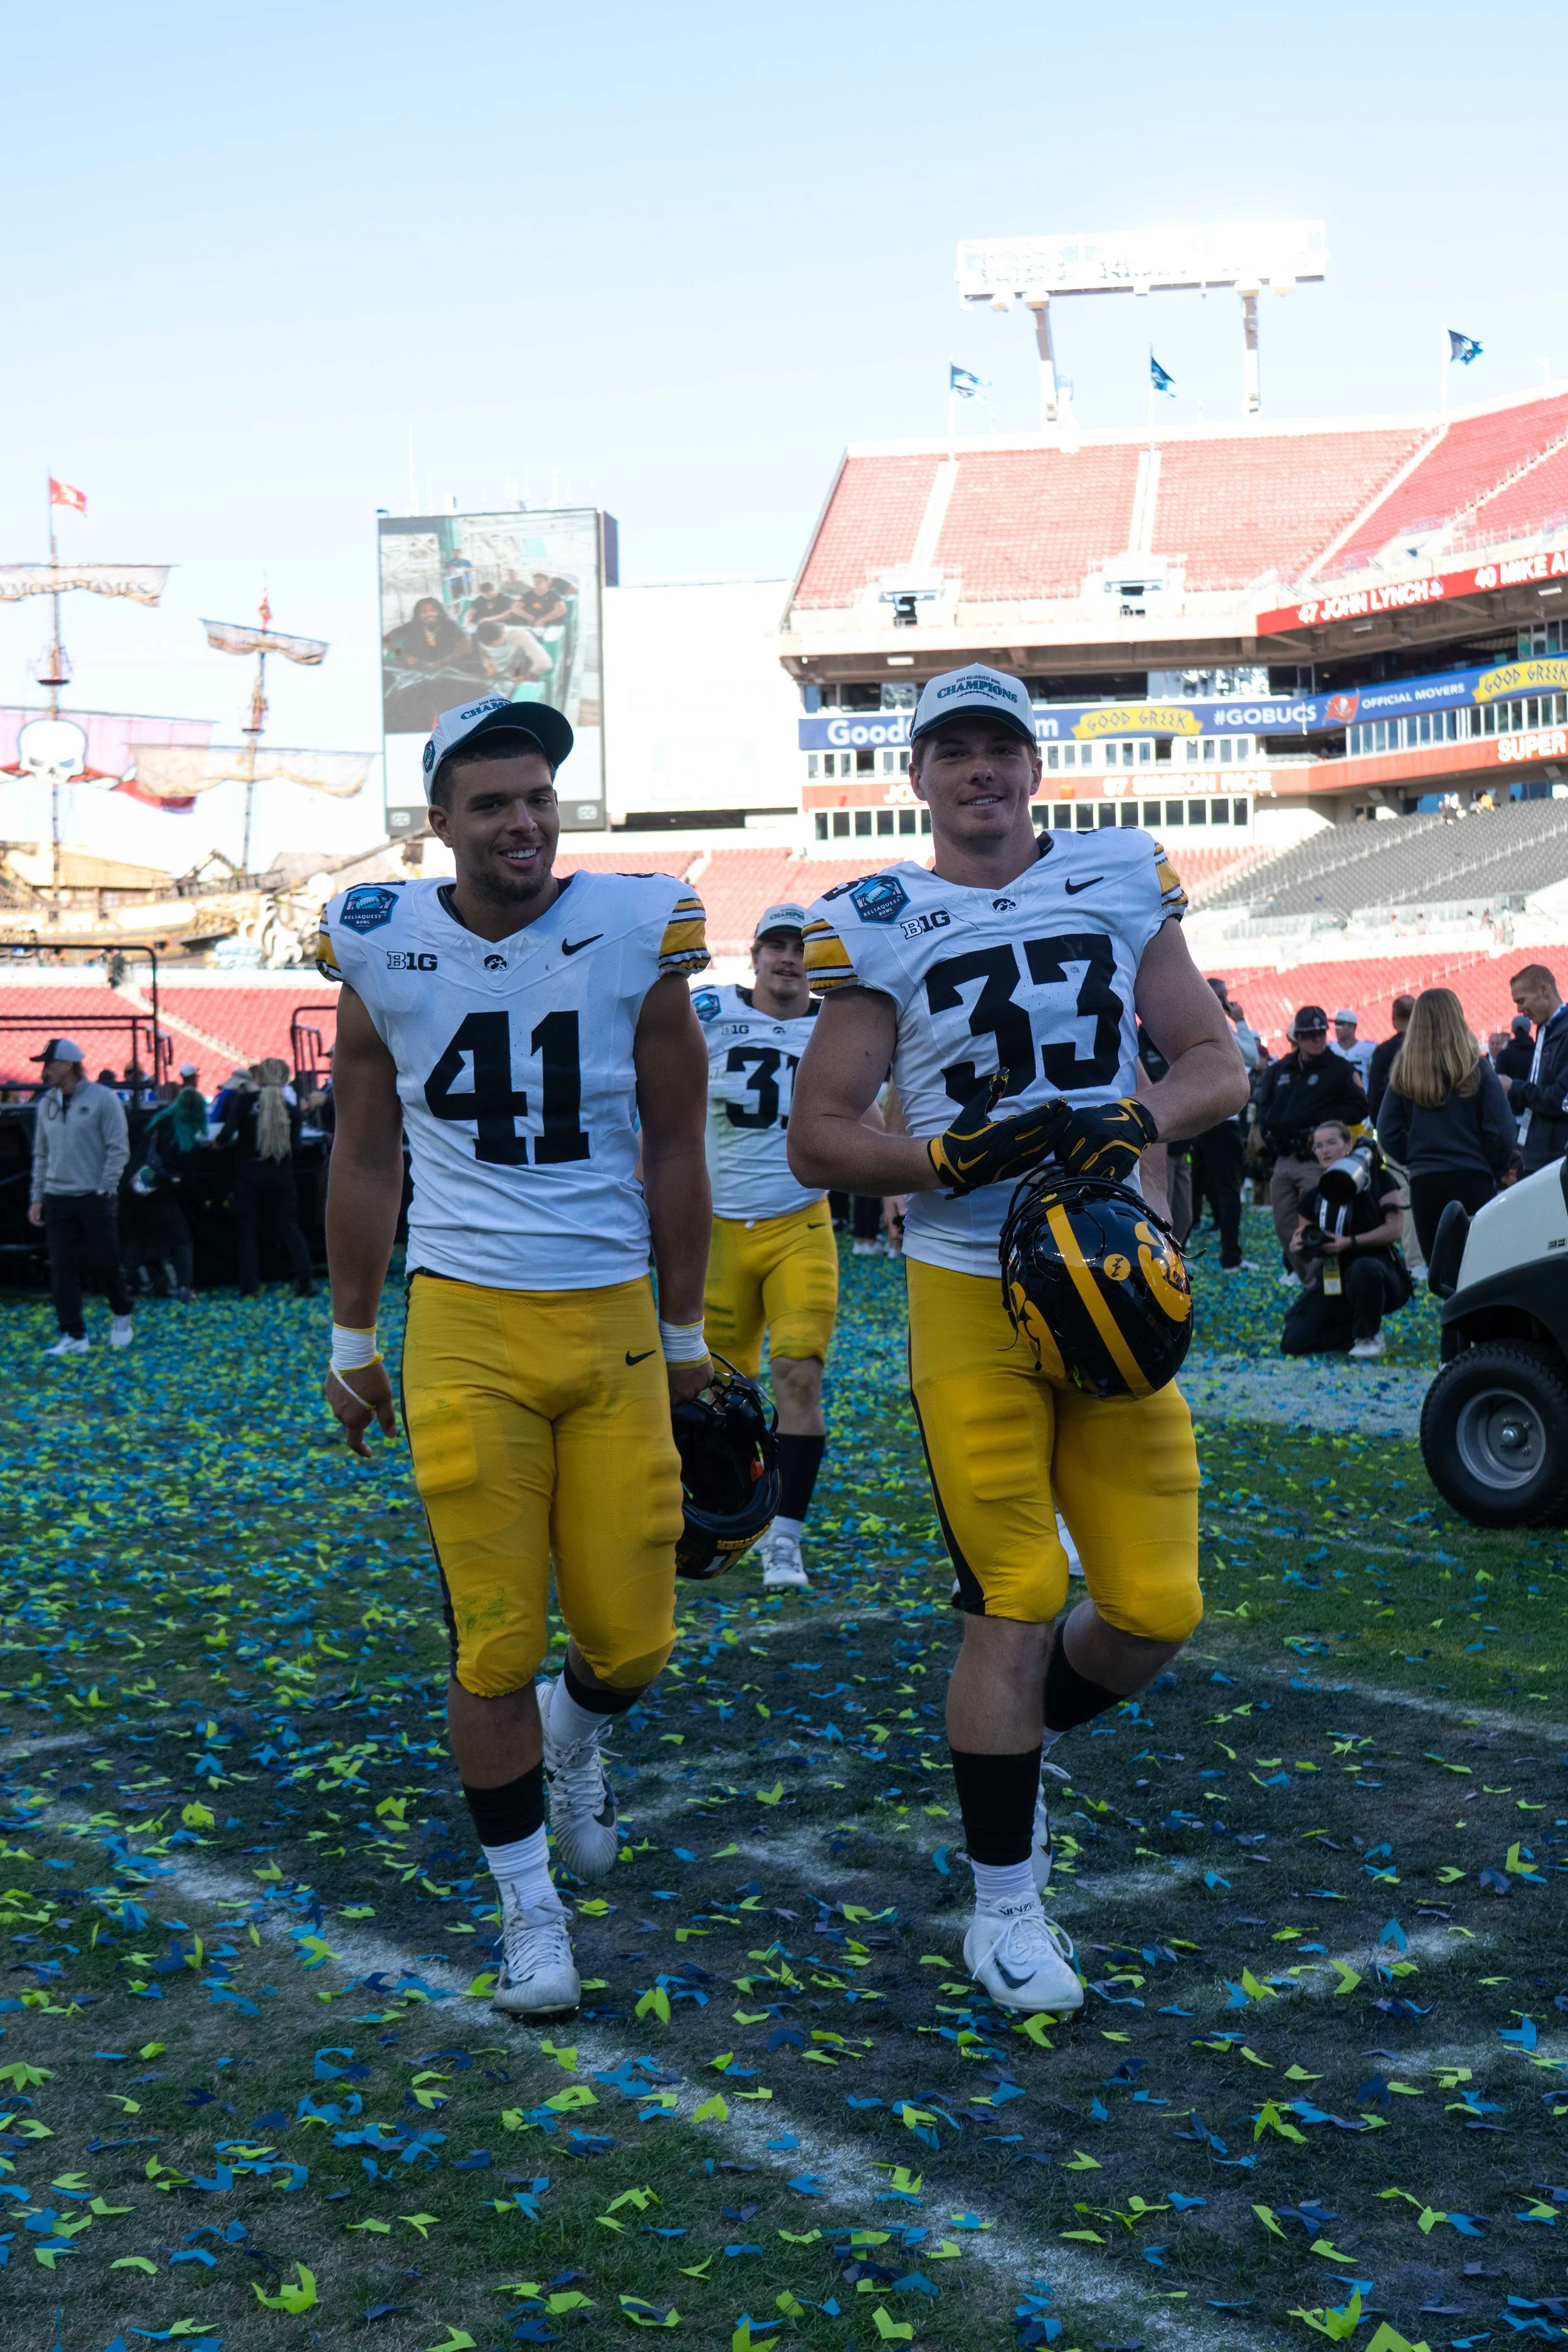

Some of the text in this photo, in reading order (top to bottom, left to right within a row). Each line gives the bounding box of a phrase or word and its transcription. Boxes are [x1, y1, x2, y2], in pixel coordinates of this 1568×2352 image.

[1475, 567, 1496, 589] 40
[1500, 555, 1548, 585] MIKE
[1298, 581, 1428, 623] 47 JOHN LYNCH
[936, 680, 1018, 704] CHAMPIONS
[1484, 663, 1568, 694] GOOD GREEK
[1361, 682, 1465, 709] OFFICIAL MOVERS
[1086, 710, 1188, 731] GOOD GREEK
[1213, 705, 1316, 726] #GOBUCS
[827, 717, 912, 746] Good
[1497, 731, 1567, 762] SUPER
[863, 898, 901, 917] RELIAQUEST
[878, 908, 893, 916] BOWL
[923, 933, 1124, 1108] 33
[423, 1010, 591, 1165] 41
